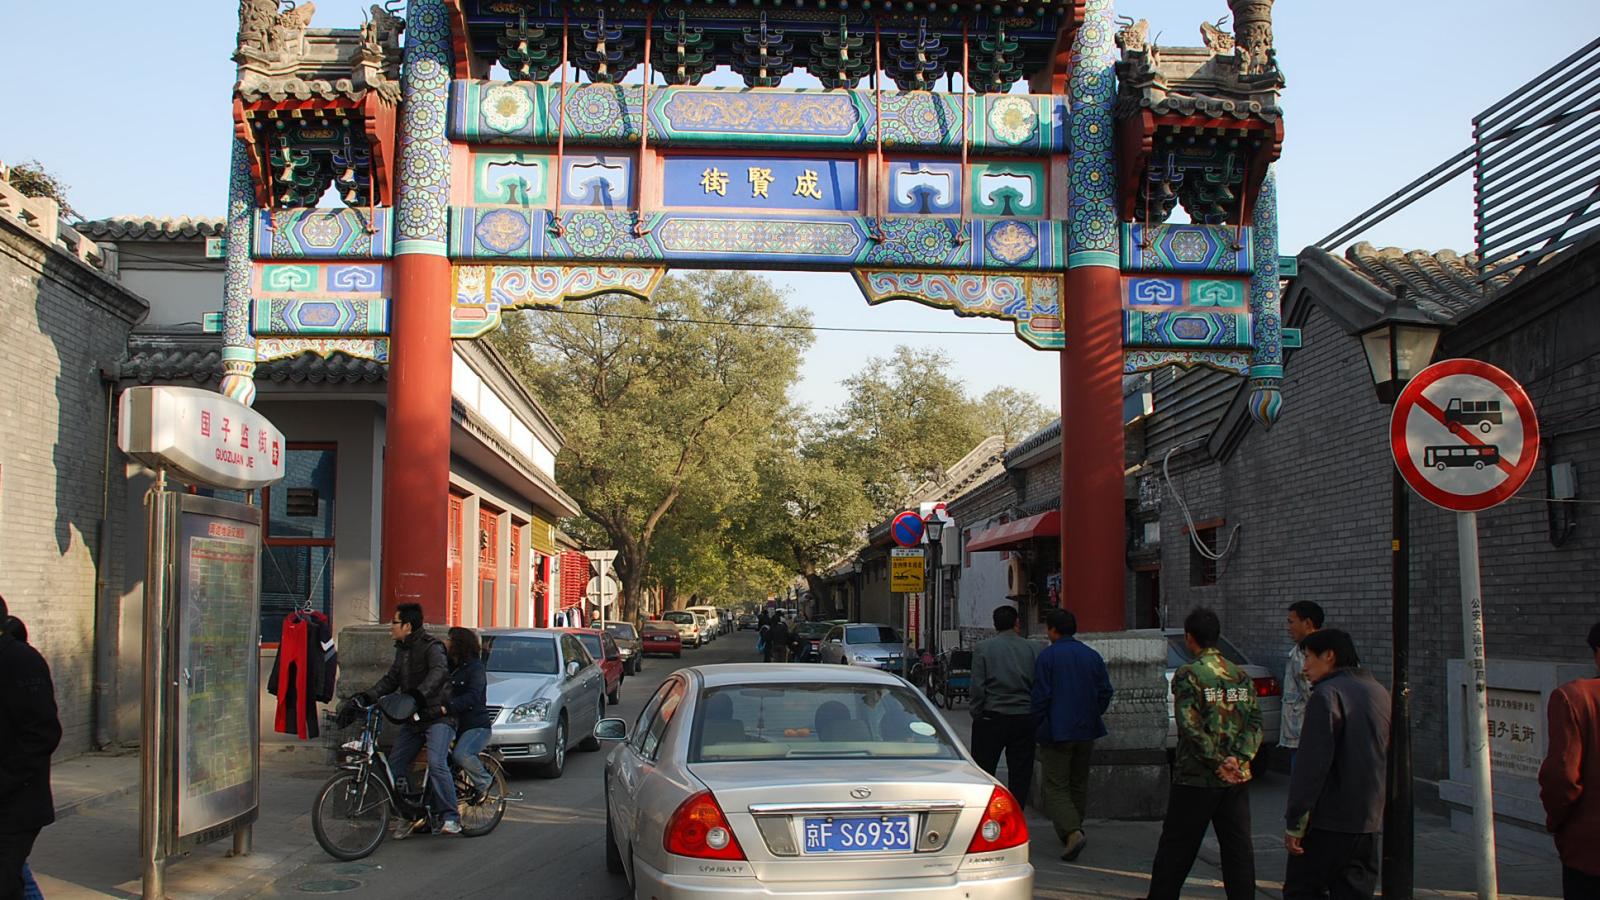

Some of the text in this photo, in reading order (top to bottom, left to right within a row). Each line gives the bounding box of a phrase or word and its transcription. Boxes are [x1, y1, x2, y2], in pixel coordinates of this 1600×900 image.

[201, 410, 267, 454] 国子监街
[215, 447, 254, 469] GUOZIJIAN JIE
